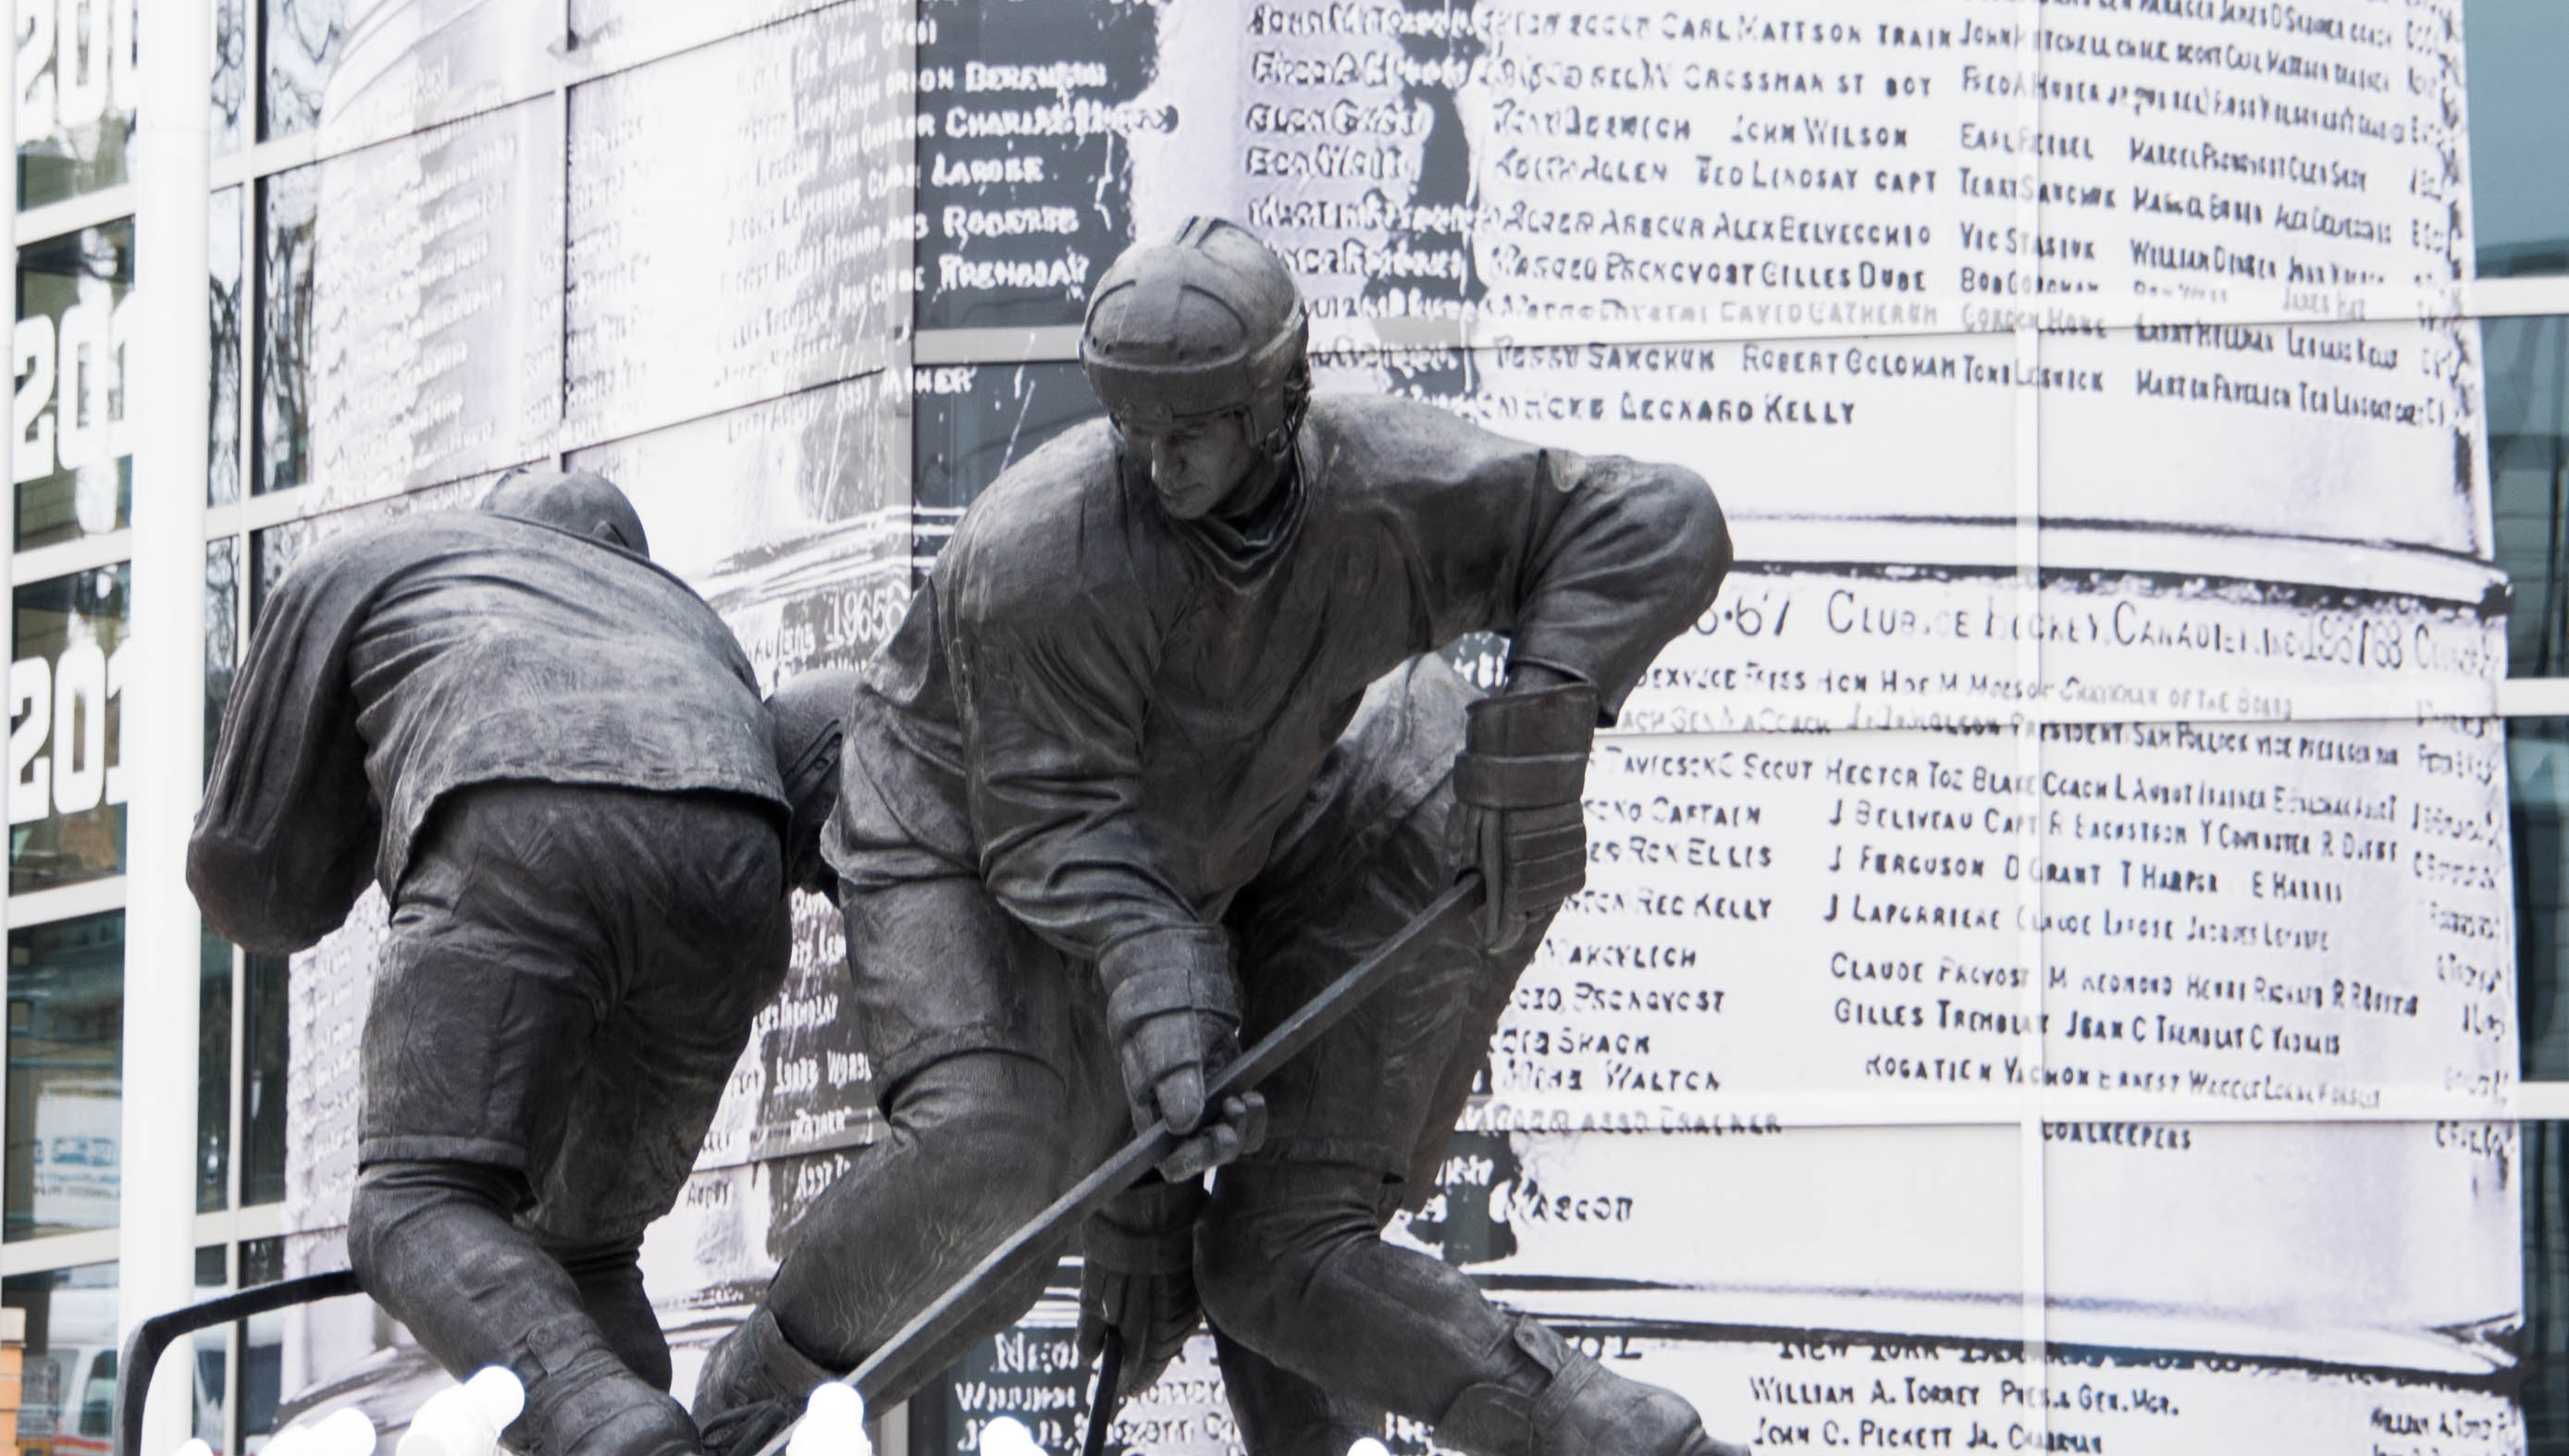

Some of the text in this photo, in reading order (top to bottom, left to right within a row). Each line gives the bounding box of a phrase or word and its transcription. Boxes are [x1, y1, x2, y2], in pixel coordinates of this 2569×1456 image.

[1764, 393, 1856, 425] KELLY
[1686, 837, 1772, 868] ELLIS
[1834, 997, 1923, 1026] GILLES
[1749, 1376, 1854, 1405] WILLIAM
